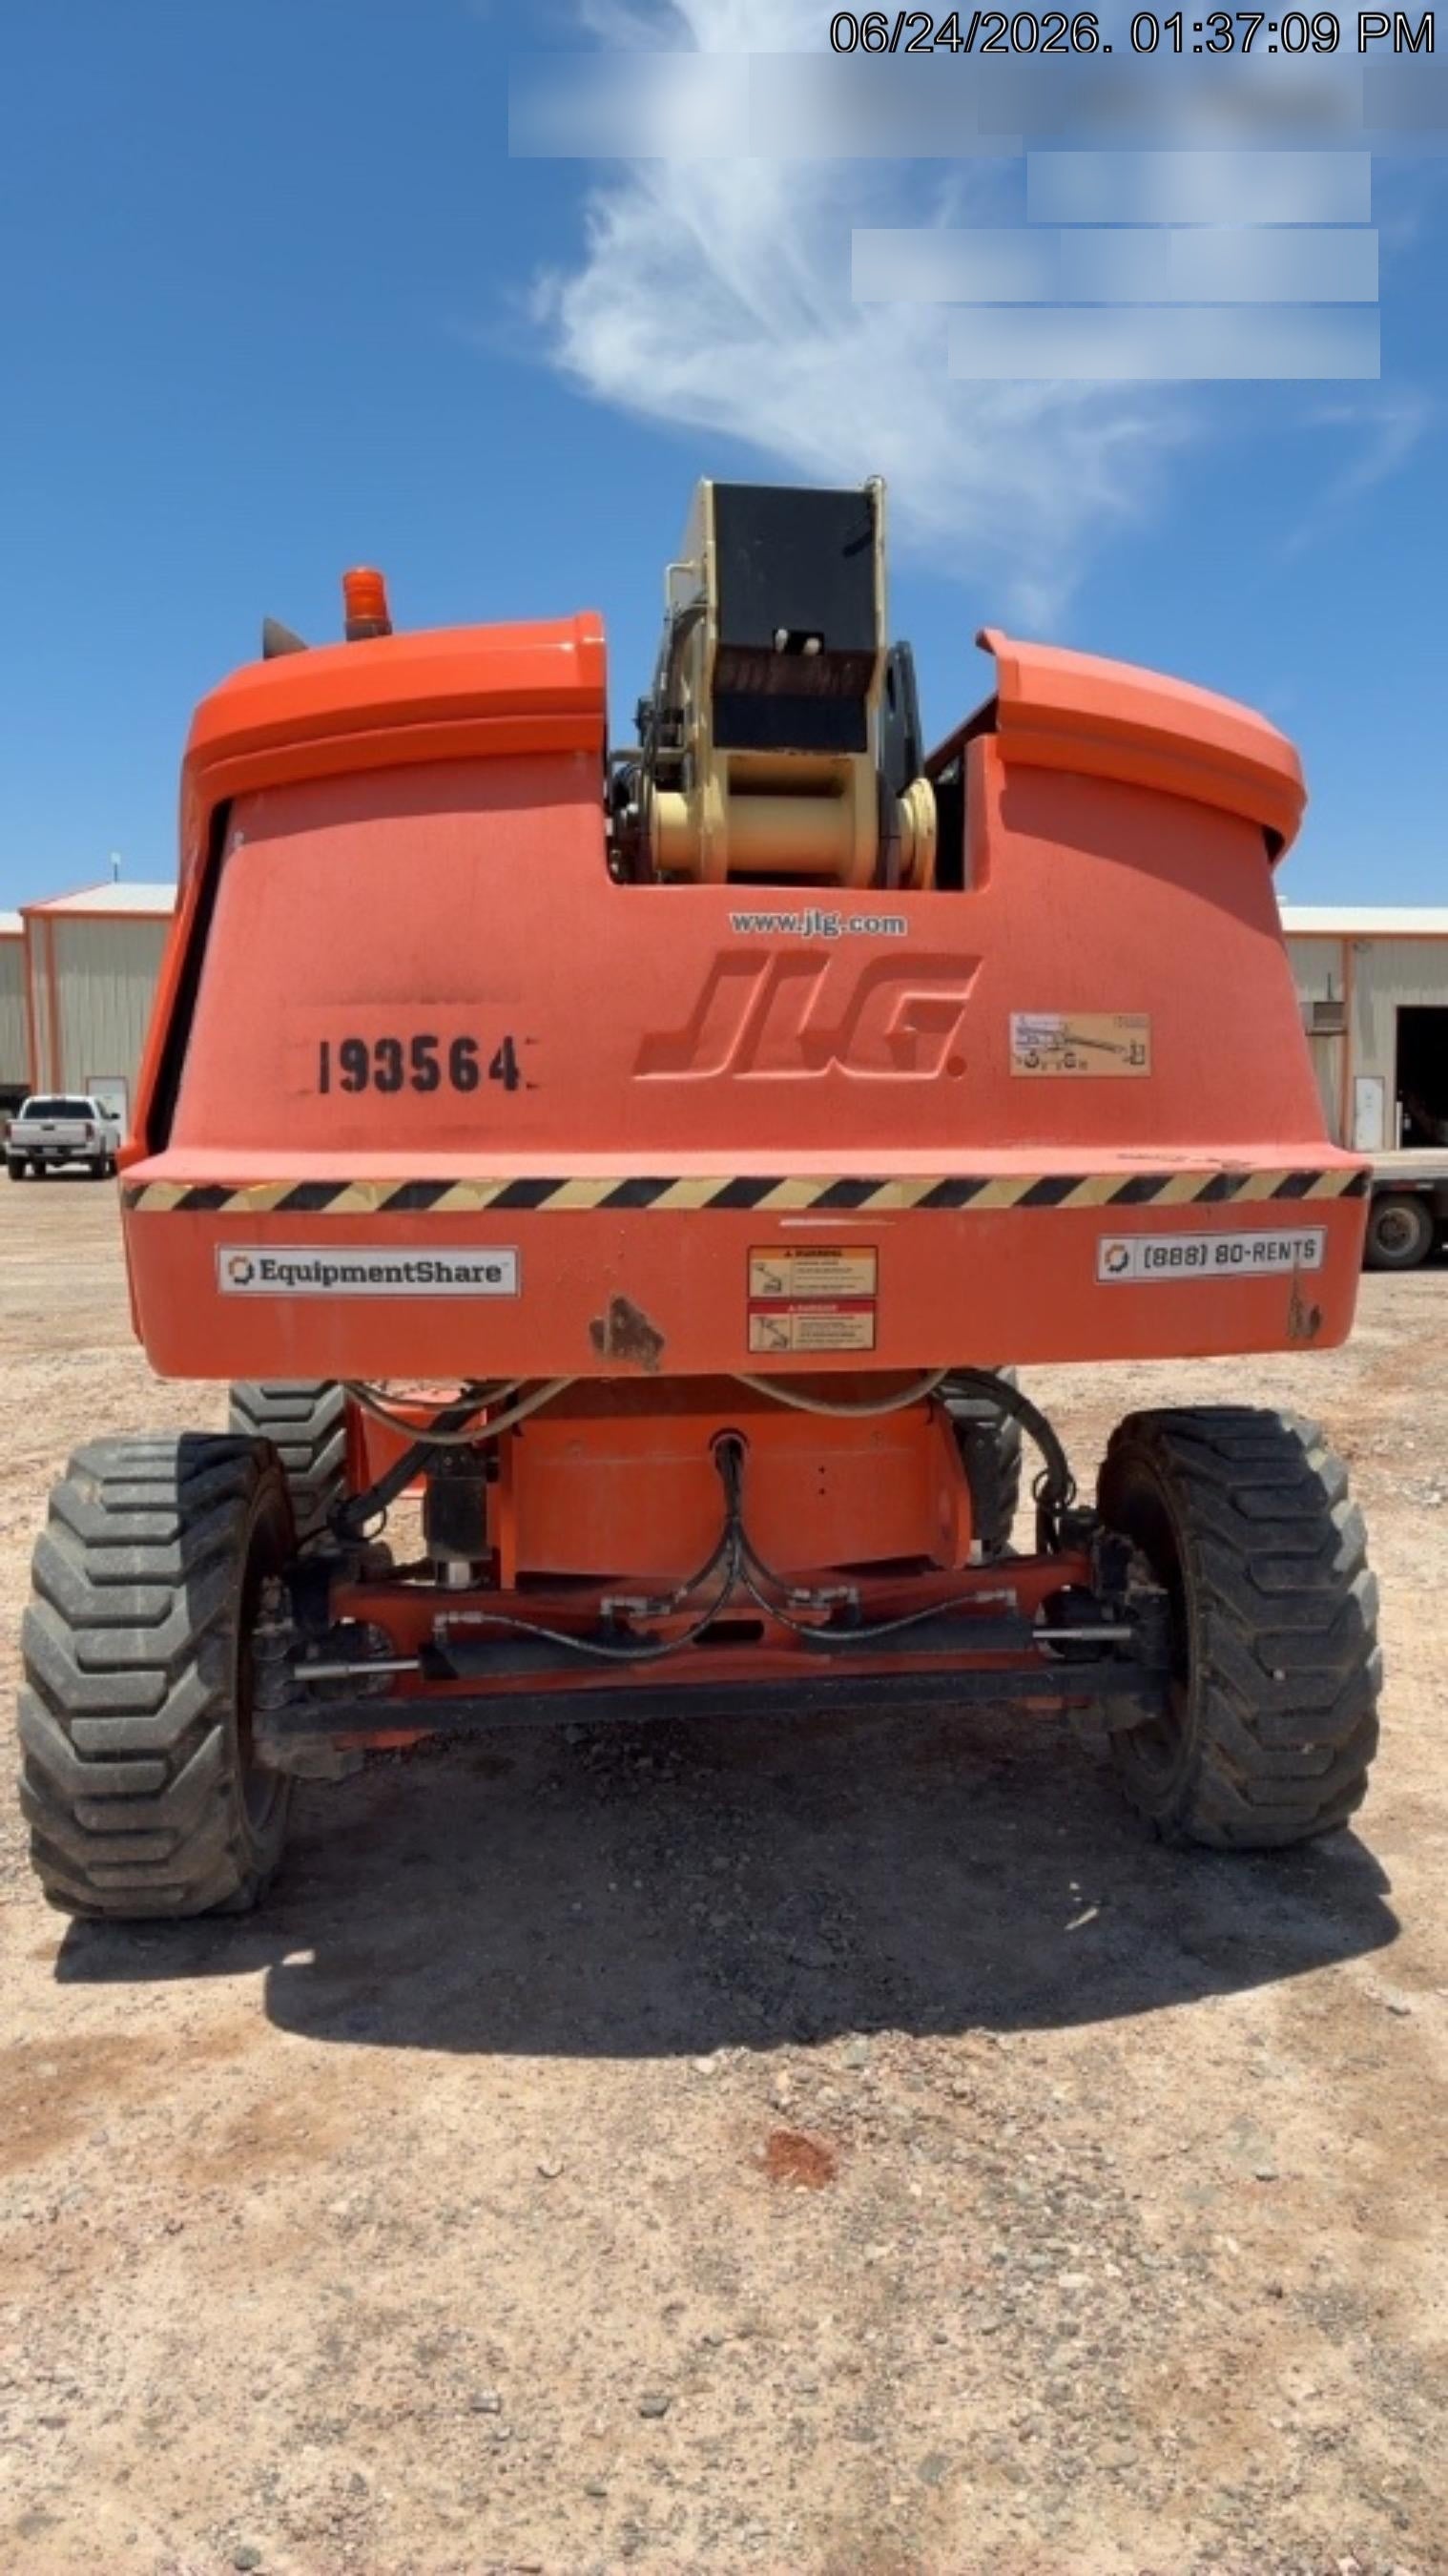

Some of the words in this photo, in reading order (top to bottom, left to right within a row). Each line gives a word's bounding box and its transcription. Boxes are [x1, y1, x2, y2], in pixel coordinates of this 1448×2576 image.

[729, 909, 907, 936] www.jlg.com
[320, 1035, 520, 1094] 193564
[259, 1258, 502, 1287] EquipmentShare
